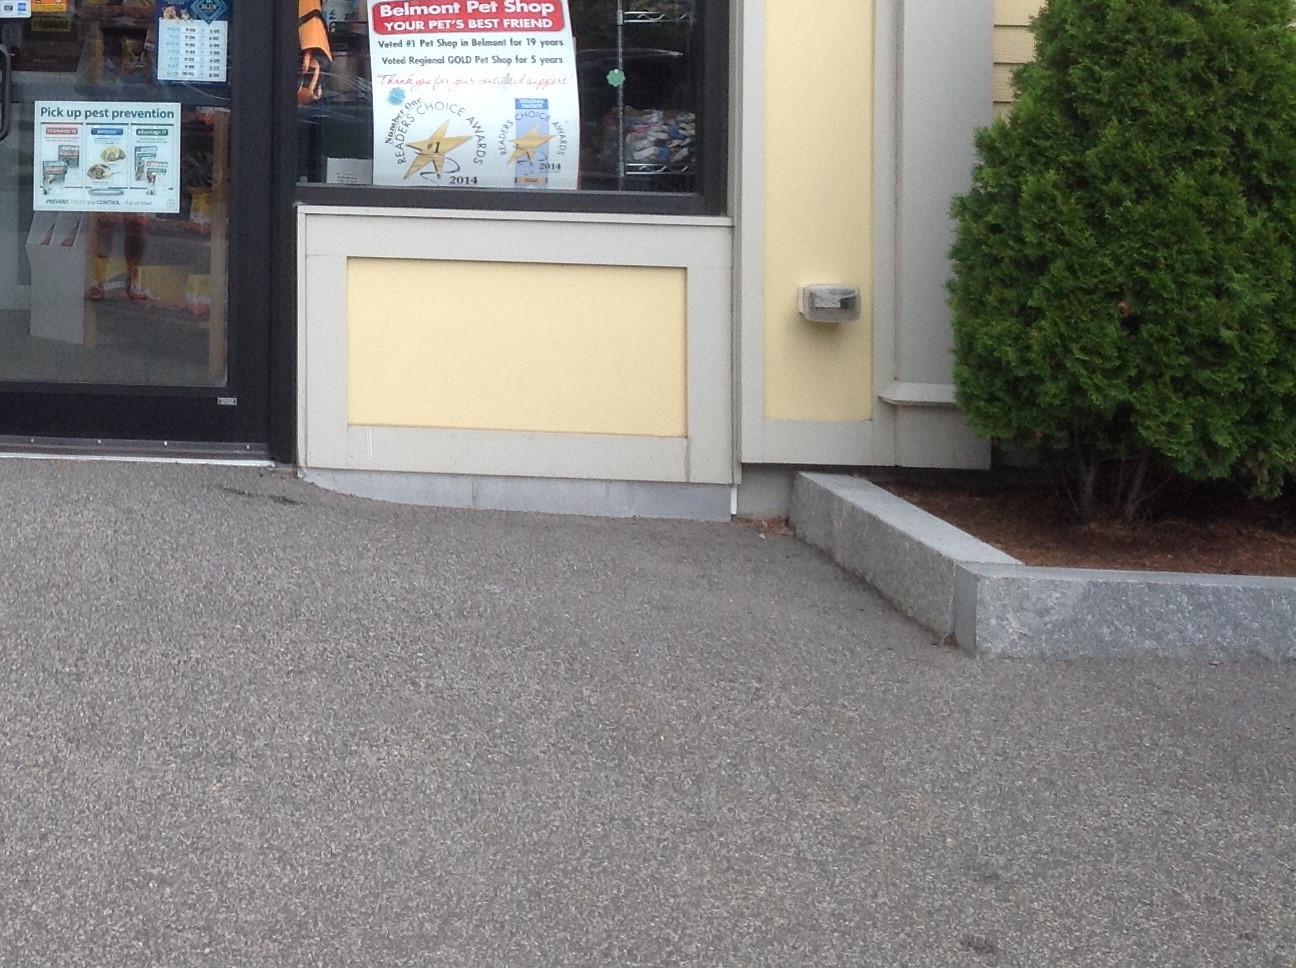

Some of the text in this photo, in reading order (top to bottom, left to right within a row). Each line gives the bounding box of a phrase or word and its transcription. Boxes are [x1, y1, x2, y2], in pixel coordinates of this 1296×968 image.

[379, 1, 461, 18] Belmont
[466, 0, 499, 15] Pet
[383, 17, 554, 31] YOUR PET'S BEST FRIEND
[378, 37, 564, 50] Voted #1 Pet Shop in Belmont for 19 years
[381, 54, 564, 67] Voted Regional GOLD Pet Shop for 5 years
[376, 73, 414, 85] Thank
[40, 106, 175, 121] Pick up pest prevention
[385, 97, 422, 144] Number One
[394, 101, 487, 165] READERS CHOICE AWARDS
[498, 110, 568, 156] READERS CHOICE AWARDS
[427, 141, 441, 154] #1
[539, 162, 562, 171] 2014
[449, 175, 478, 185] 2014
